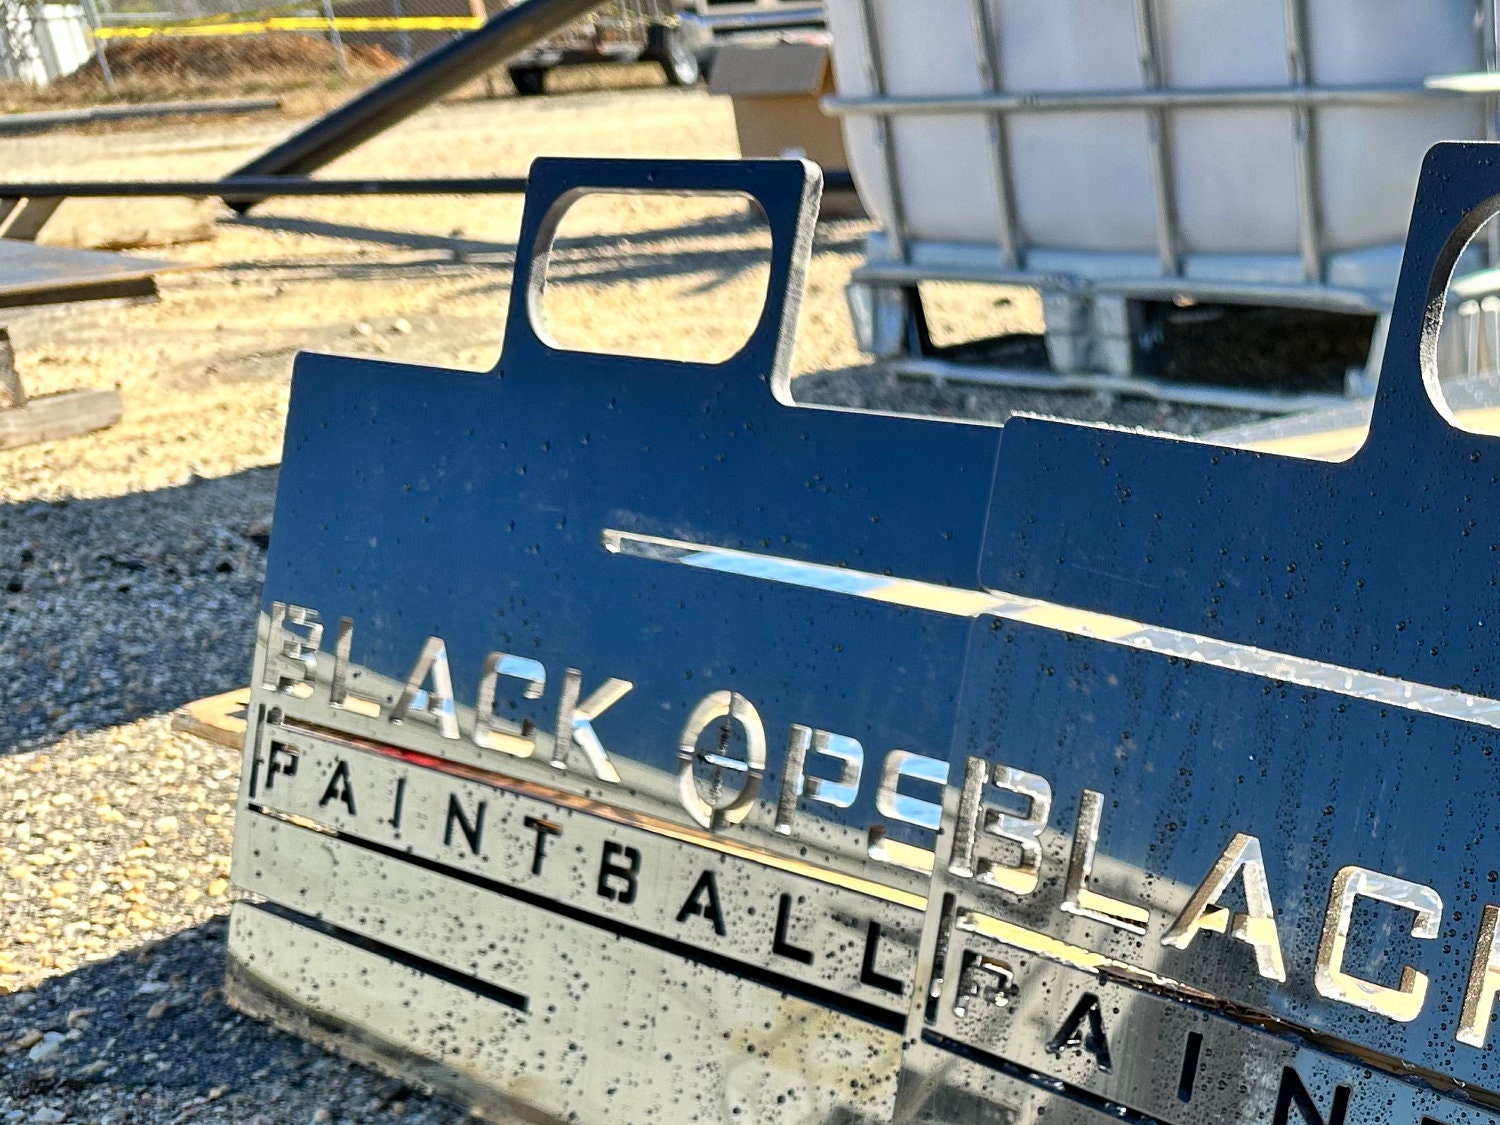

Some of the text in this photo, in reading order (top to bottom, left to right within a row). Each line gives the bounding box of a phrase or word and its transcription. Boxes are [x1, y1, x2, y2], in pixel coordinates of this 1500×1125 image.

[261, 600, 950, 877] BLACK OPS
[265, 740, 904, 995] PAINTBALL
